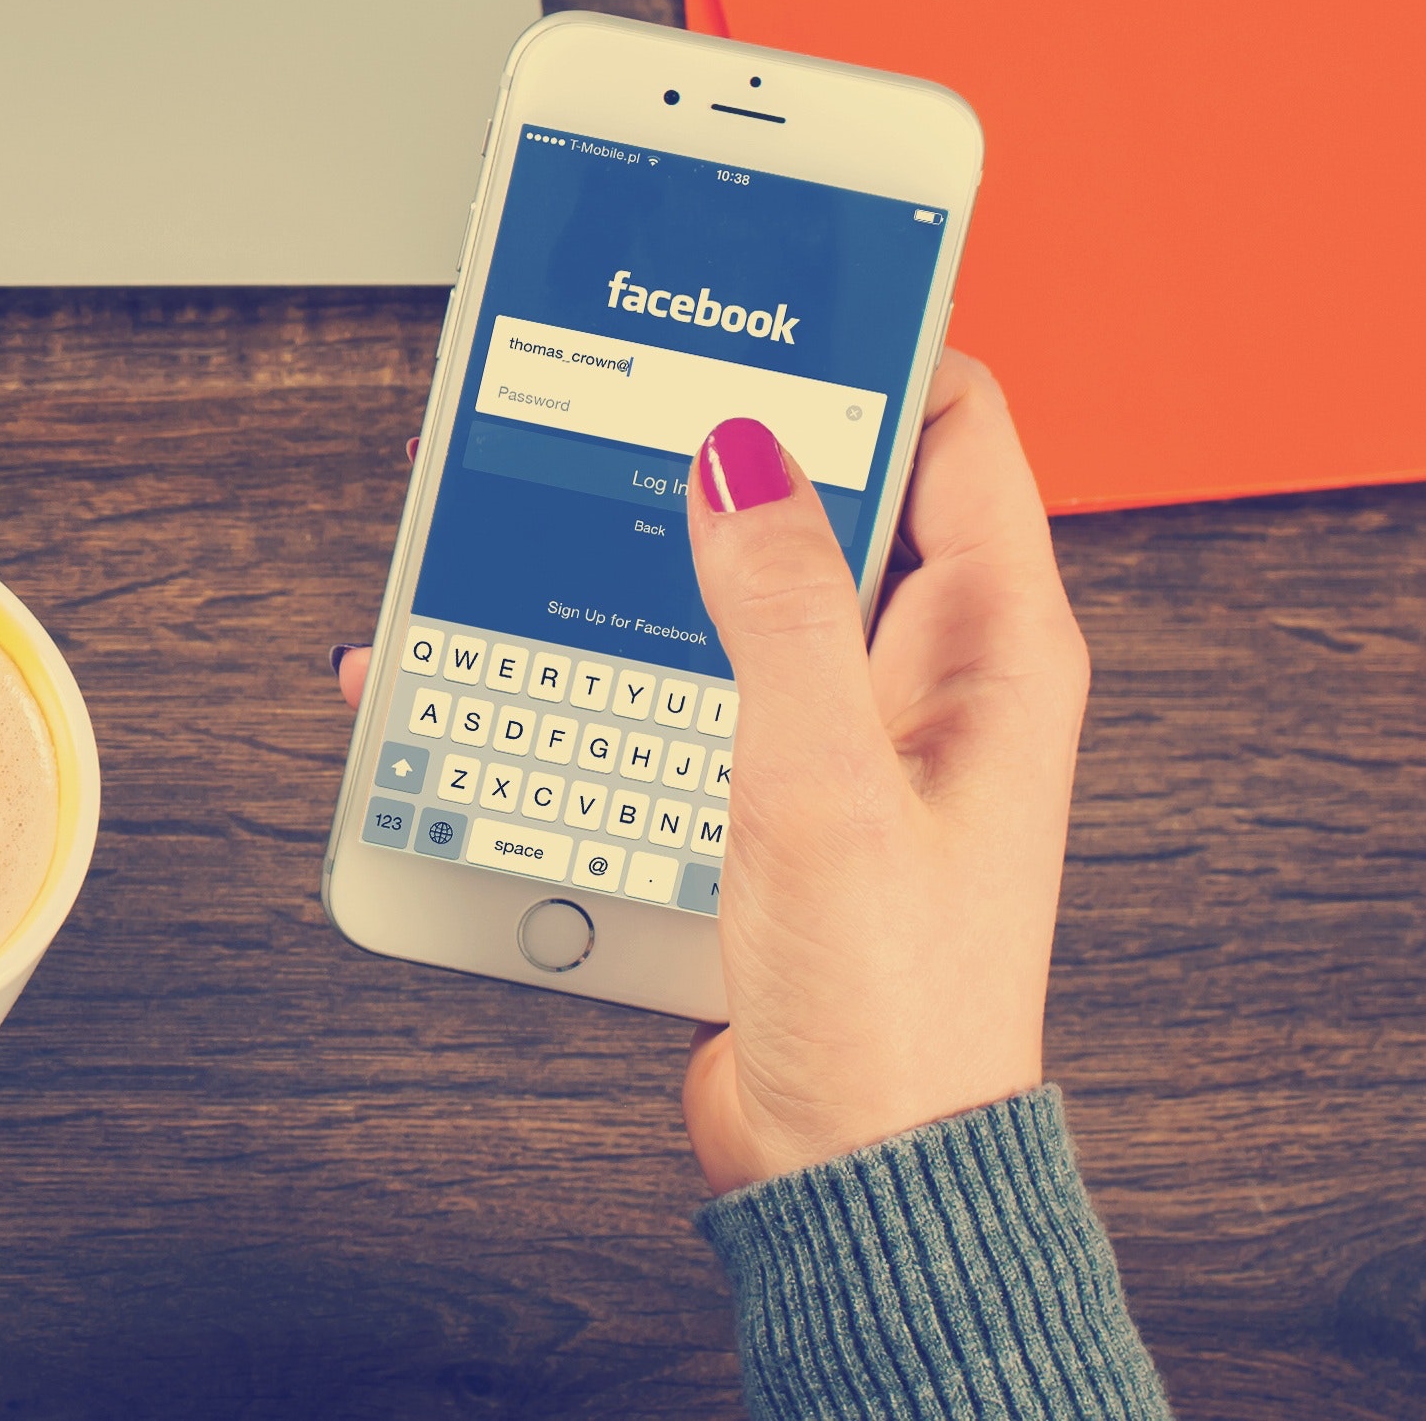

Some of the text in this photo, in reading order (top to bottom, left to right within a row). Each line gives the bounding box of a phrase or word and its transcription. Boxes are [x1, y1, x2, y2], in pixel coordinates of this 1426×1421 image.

[569, 139, 641, 165] T-Mobile.pl
[715, 169, 751, 186] 10:38
[607, 270, 800, 345] facebook
[509, 338, 630, 374] thomas_crown@
[498, 387, 571, 412] Password
[633, 470, 689, 495] Log In
[634, 519, 666, 537] Back
[548, 600, 708, 646] Sign Up for Facebook
[413, 641, 432, 662] Q
[456, 649, 478, 670] W
[499, 659, 515, 678] E
[541, 667, 558, 688] R
[586, 676, 600, 695] T
[628, 684, 644, 704] Y
[668, 693, 685, 713] U
[715, 703, 721, 721] I
[420, 704, 437, 723] A
[464, 713, 480, 731] S
[505, 720, 523, 739] D
[549, 730, 565, 747] F
[590, 738, 608, 759] G
[632, 747, 651, 767] H
[677, 757, 690, 775] J
[716, 765, 731, 785] K
[451, 769, 467, 789] Z
[492, 778, 510, 798] X
[534, 787, 552, 806] C
[580, 796, 595, 815] V
[374, 813, 402, 832] 123
[620, 805, 636, 824] B
[661, 813, 680, 834] N
[700, 821, 723, 843] M
[494, 838, 545, 861] space
[589, 857, 608, 876] @
